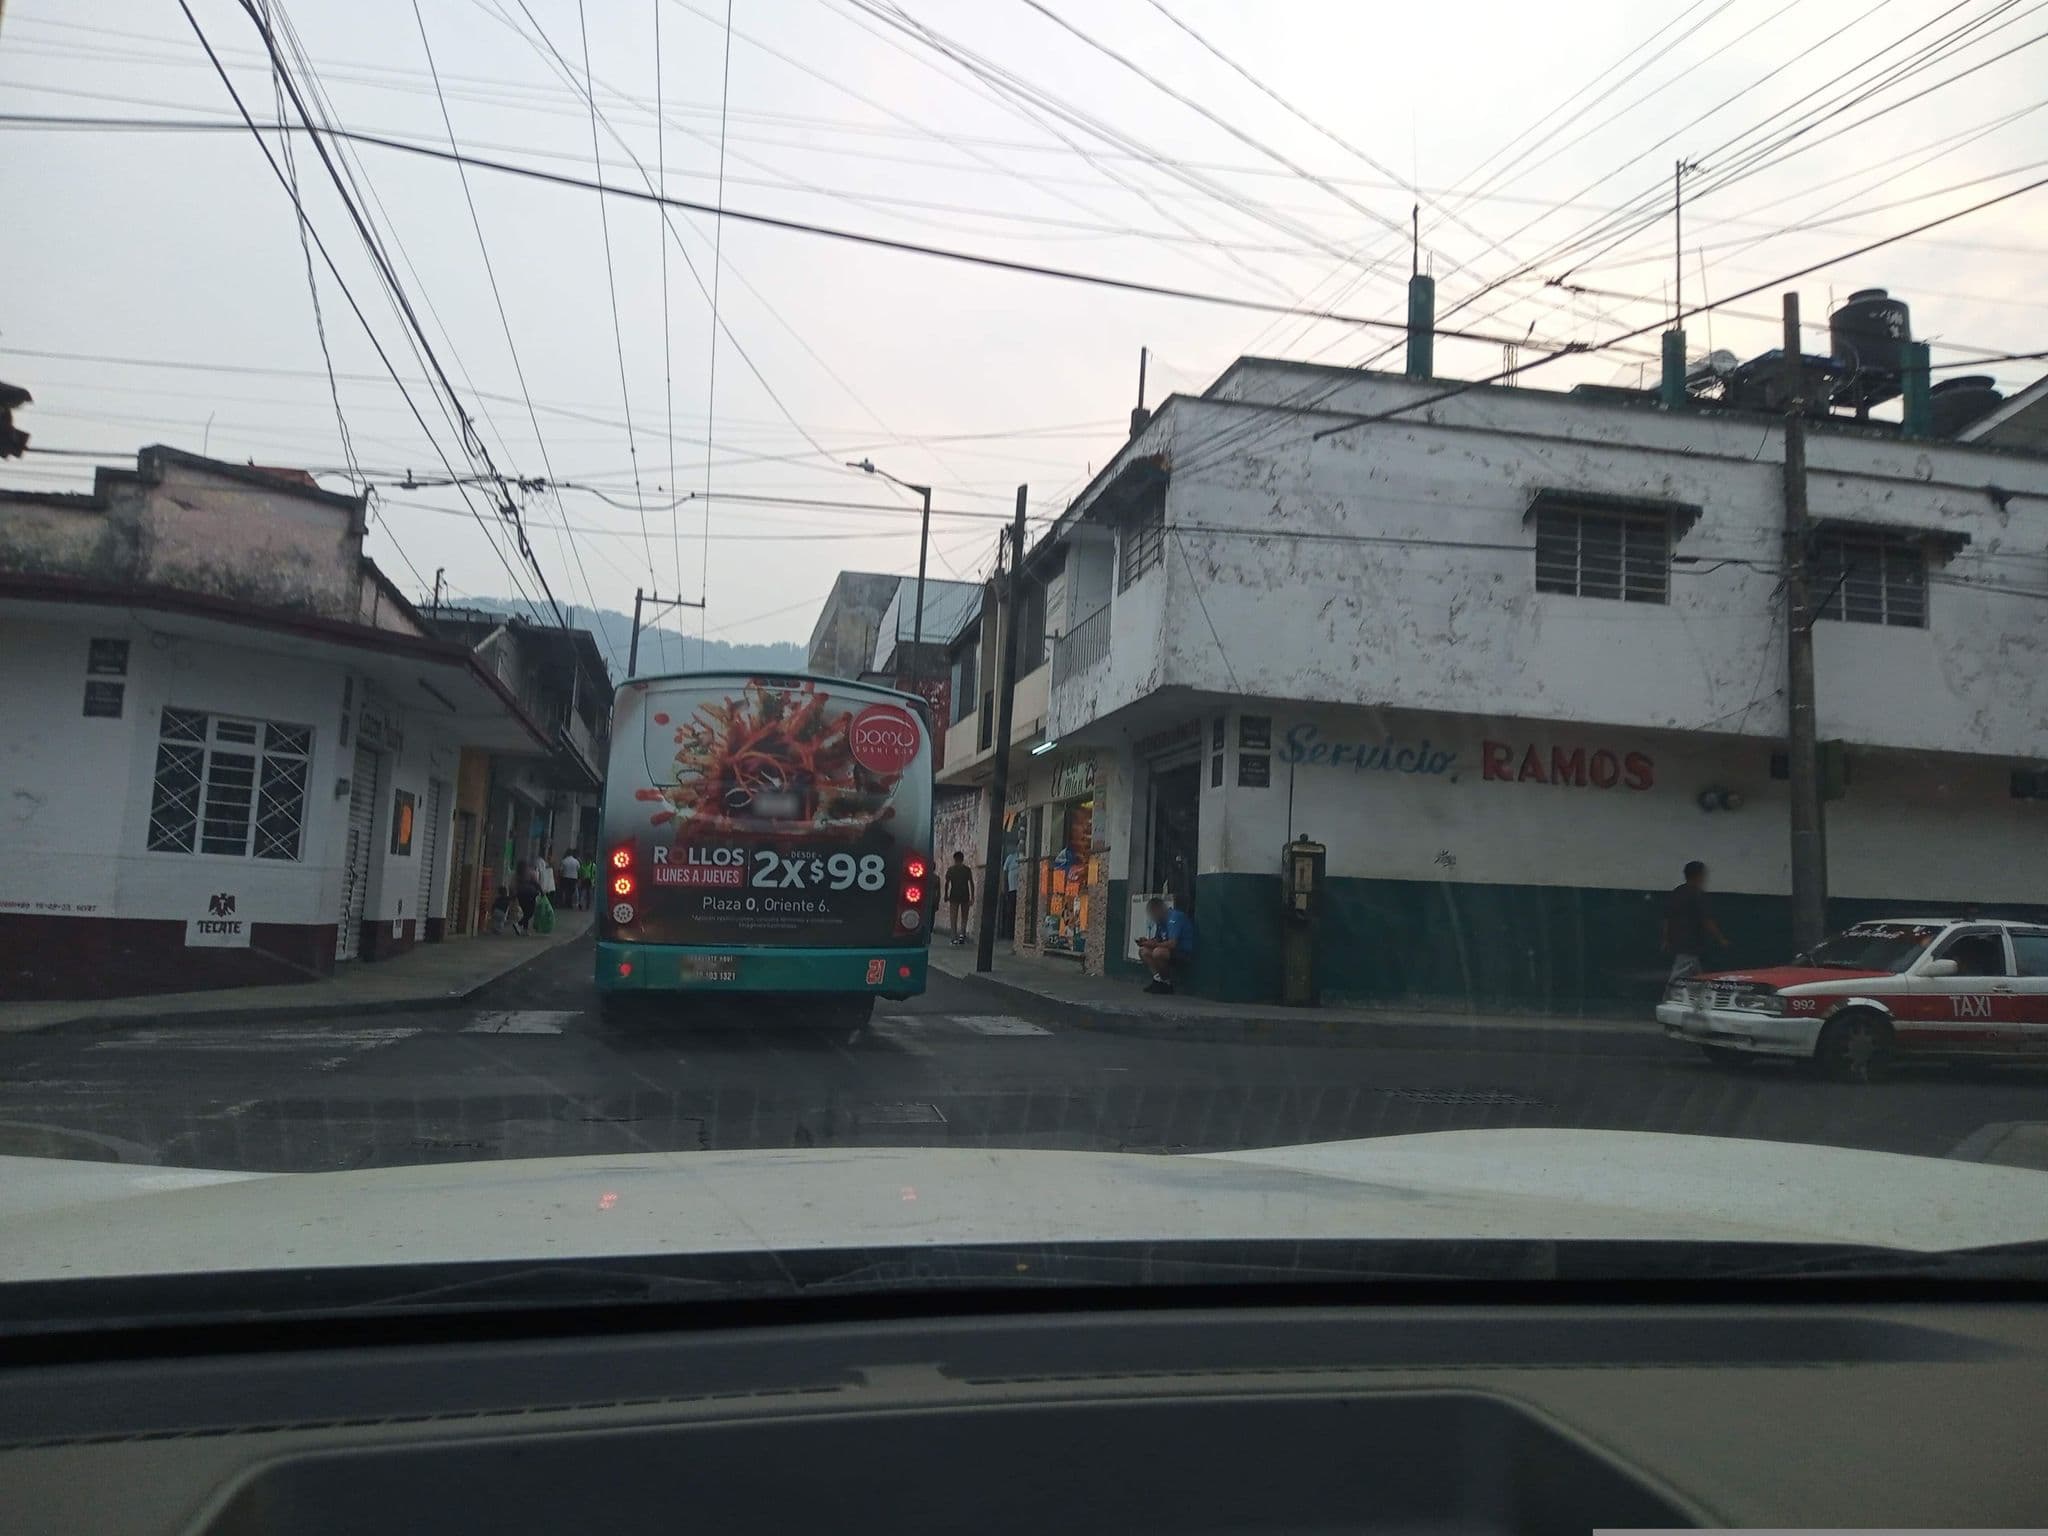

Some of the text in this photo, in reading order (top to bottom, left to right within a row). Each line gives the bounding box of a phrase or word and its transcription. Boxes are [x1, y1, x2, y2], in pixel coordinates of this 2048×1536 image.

[1482, 739, 1654, 790] RAMOS
[653, 846, 745, 866] ROLLOS
[656, 868, 740, 884] LUNES A JUEVES
[702, 896, 741, 911] Plaza
[764, 897, 815, 912] Oriente
[197, 920, 242, 934] TECATE
[867, 960, 885, 984] 21
[1792, 999, 1816, 1011] 992
[1949, 994, 1993, 1017] TAXI
